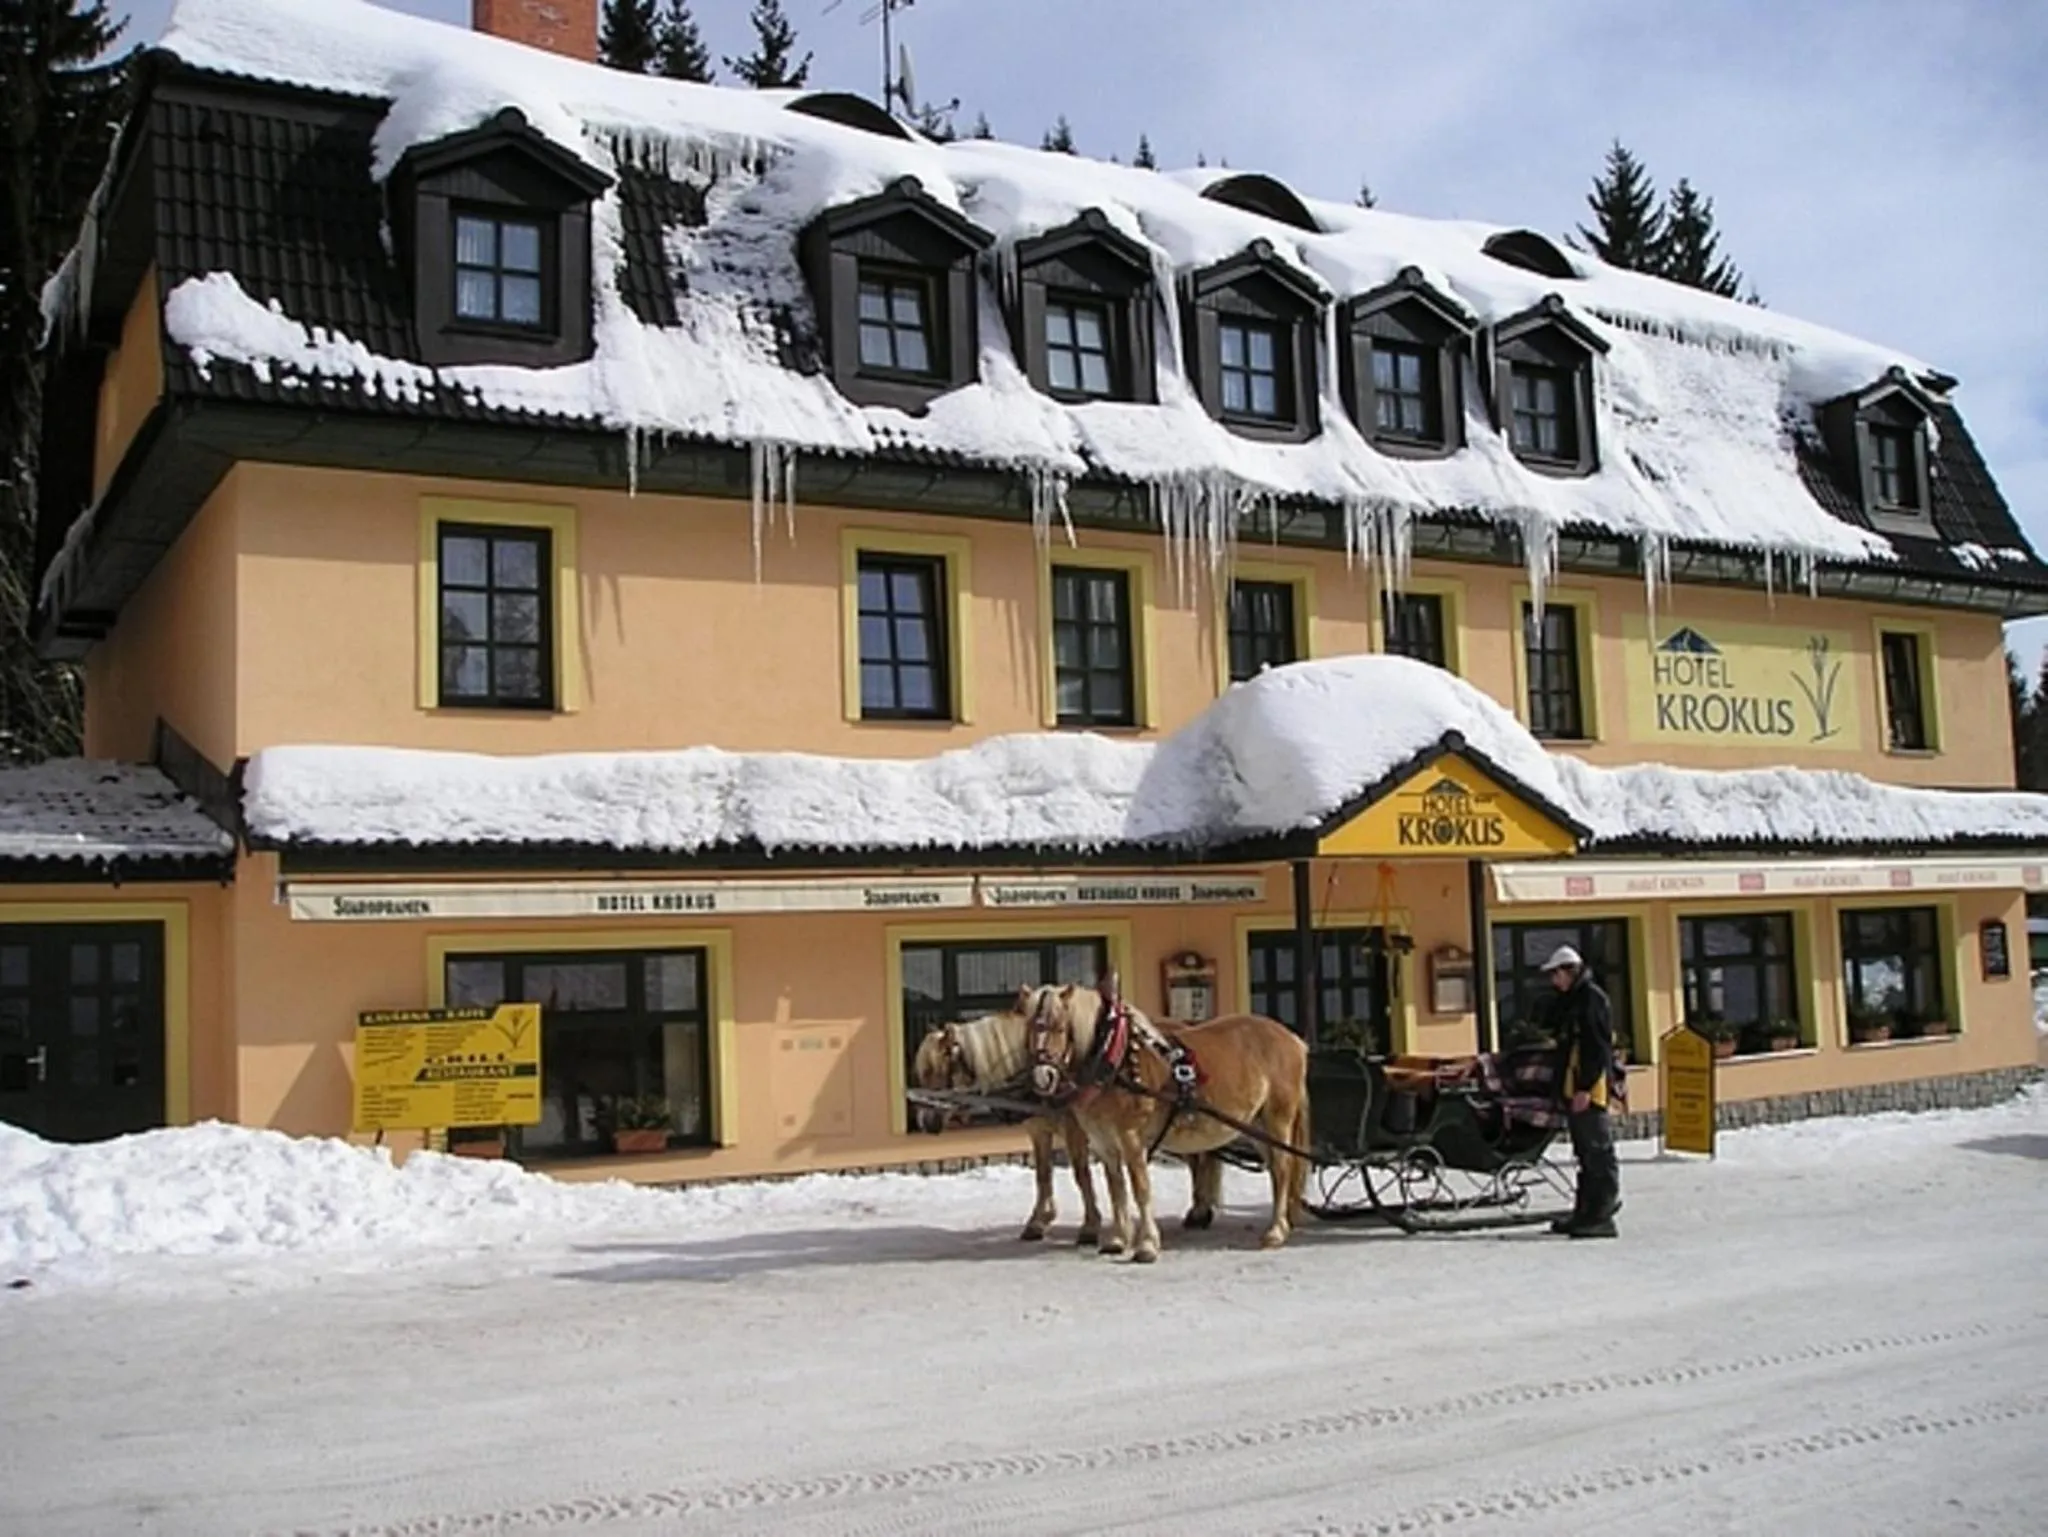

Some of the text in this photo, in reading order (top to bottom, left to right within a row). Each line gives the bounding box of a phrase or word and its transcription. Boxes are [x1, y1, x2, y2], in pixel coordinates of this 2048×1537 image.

[1653, 655, 1734, 689] HOTEL
[1657, 693, 1795, 735] KROKUS
[1422, 795, 1473, 815] HOTEL
[1398, 816, 1505, 845] KROKUS
[597, 896, 645, 911] HOTEL
[652, 894, 716, 910] KROKUS
